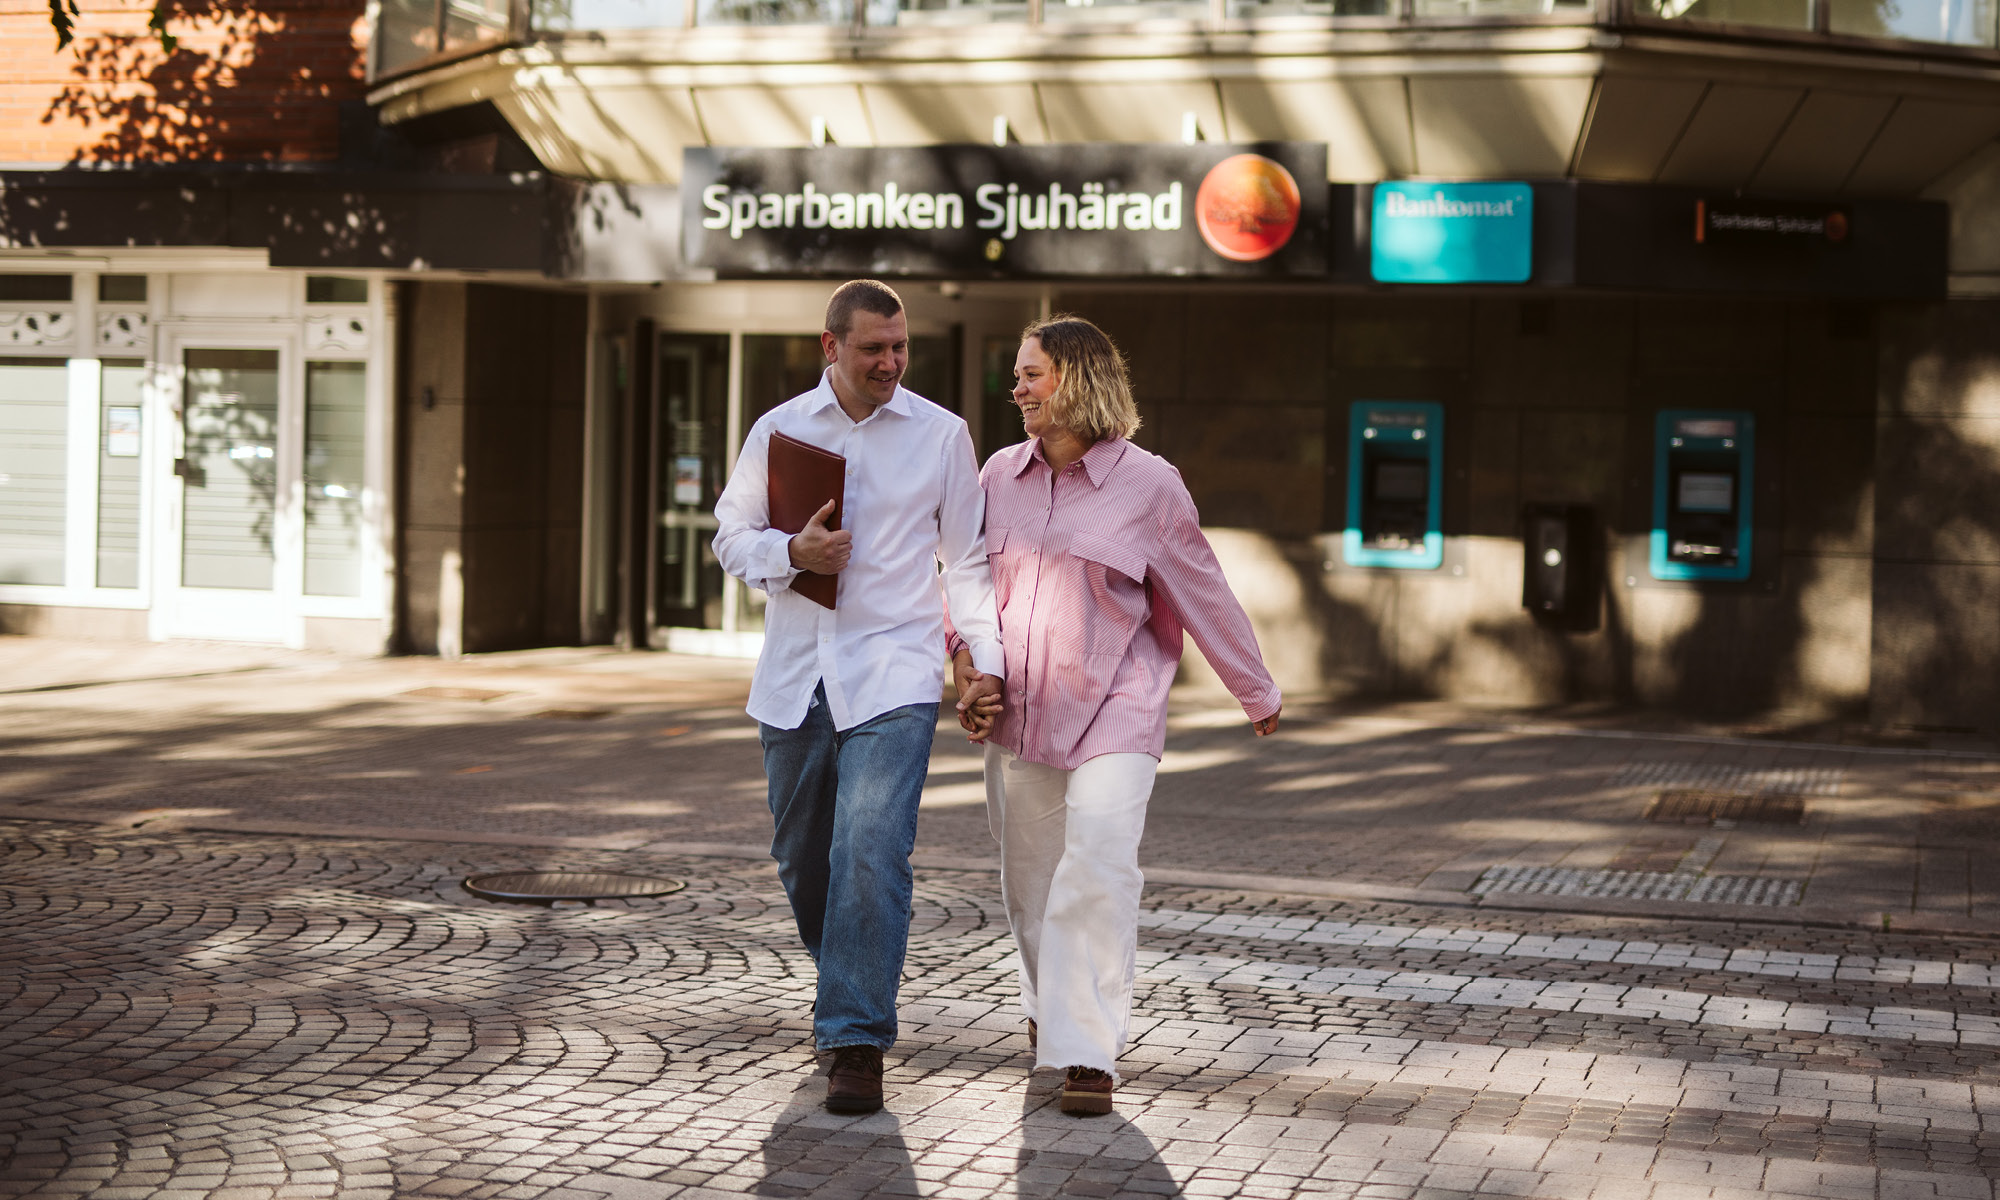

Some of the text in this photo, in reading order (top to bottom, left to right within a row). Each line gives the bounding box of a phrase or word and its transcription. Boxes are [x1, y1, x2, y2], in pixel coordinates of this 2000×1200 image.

[703, 182, 1183, 240] Sparbanken Sjuhärad
[1386, 191, 1514, 218] Bankomat
